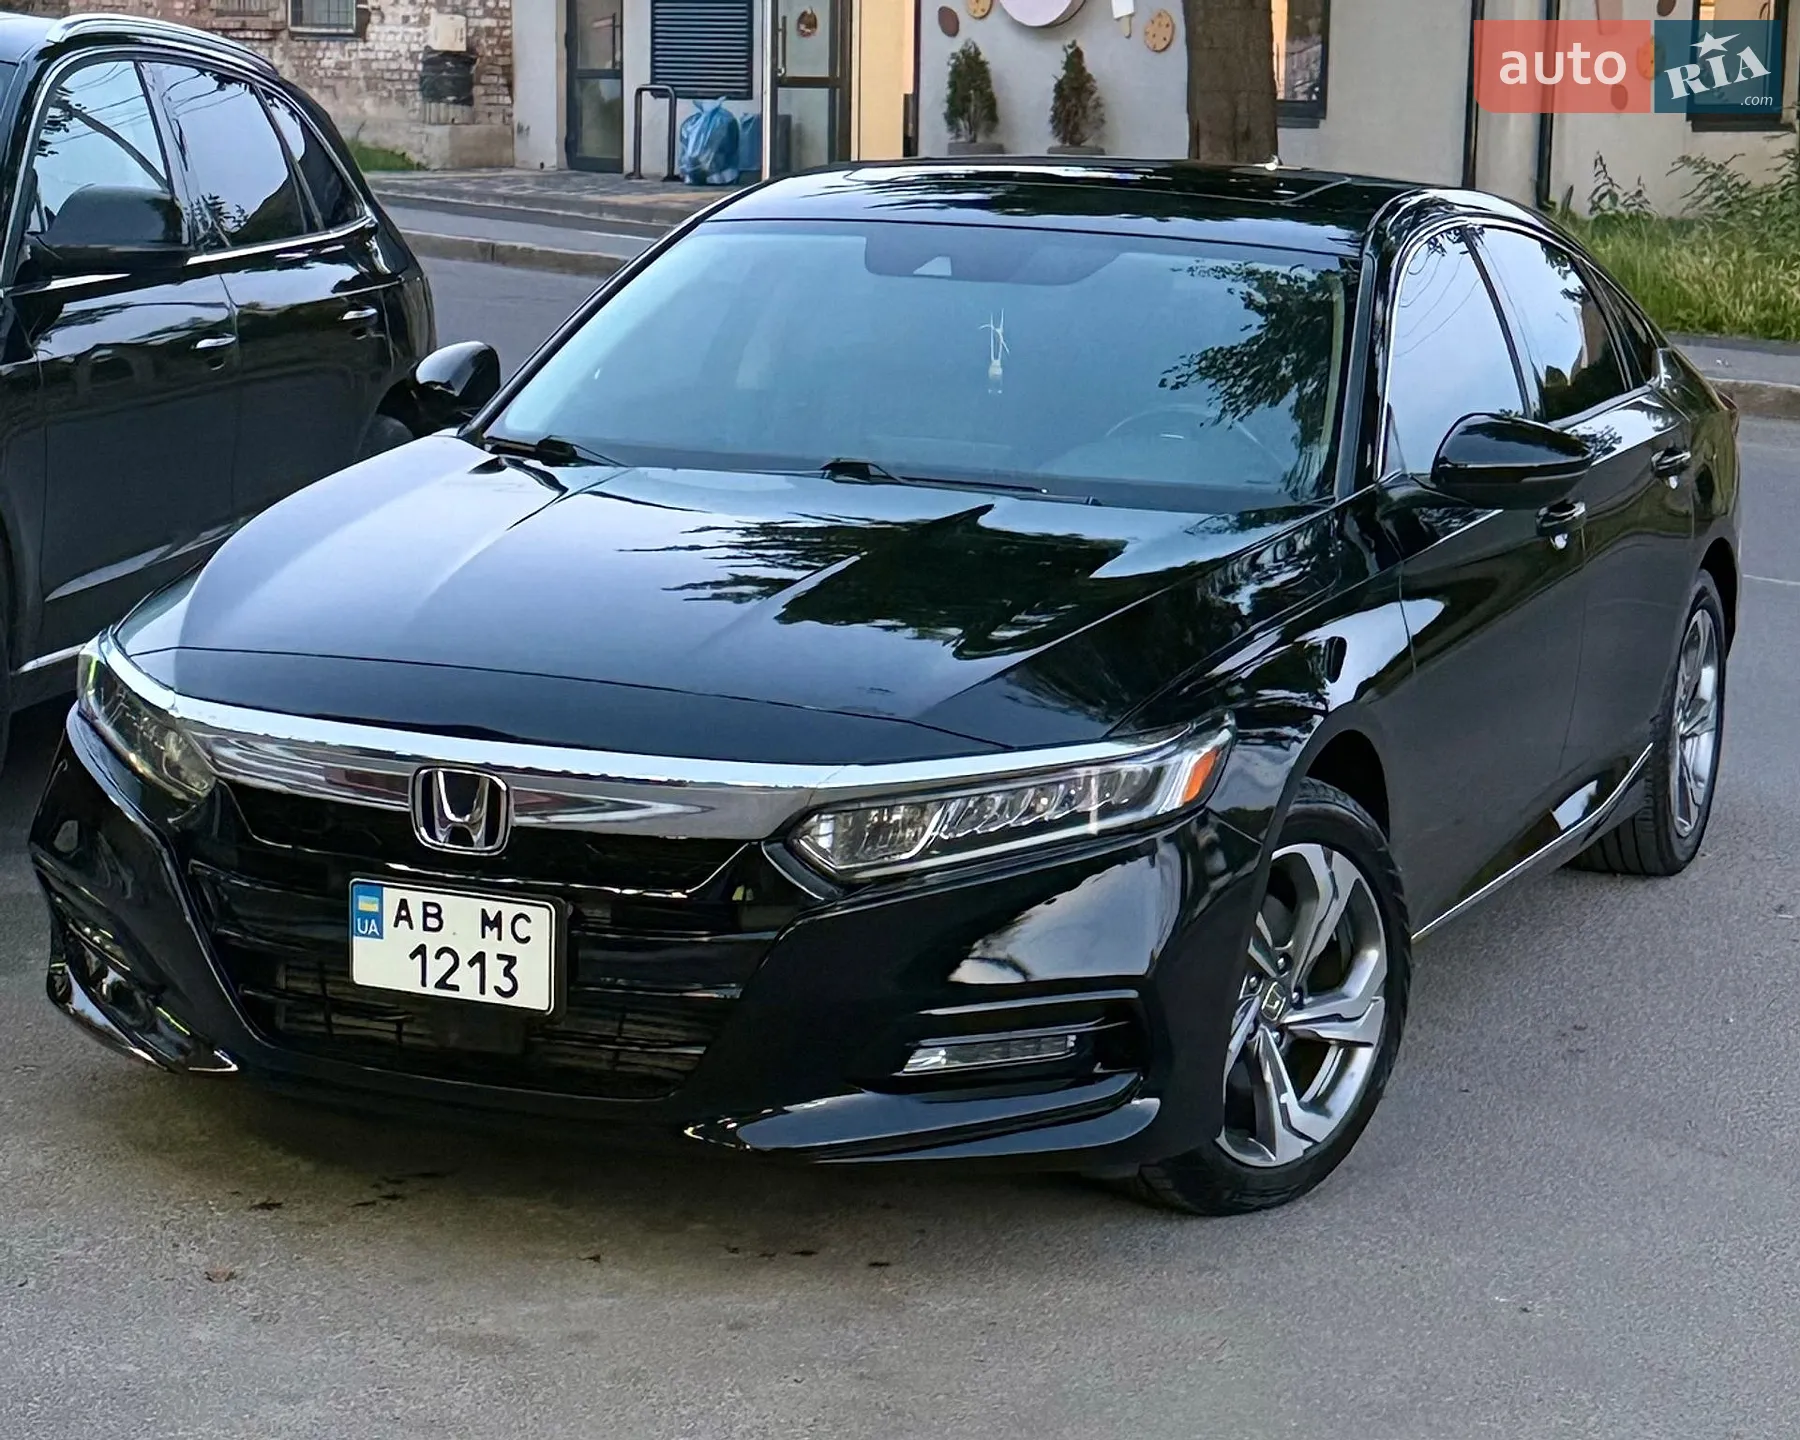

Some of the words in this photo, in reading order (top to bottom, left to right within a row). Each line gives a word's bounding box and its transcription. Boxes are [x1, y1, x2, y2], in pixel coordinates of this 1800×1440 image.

[357, 917, 380, 936] UA
[393, 898, 444, 933] AB
[481, 908, 532, 944] MC
[409, 943, 519, 999] 1213
